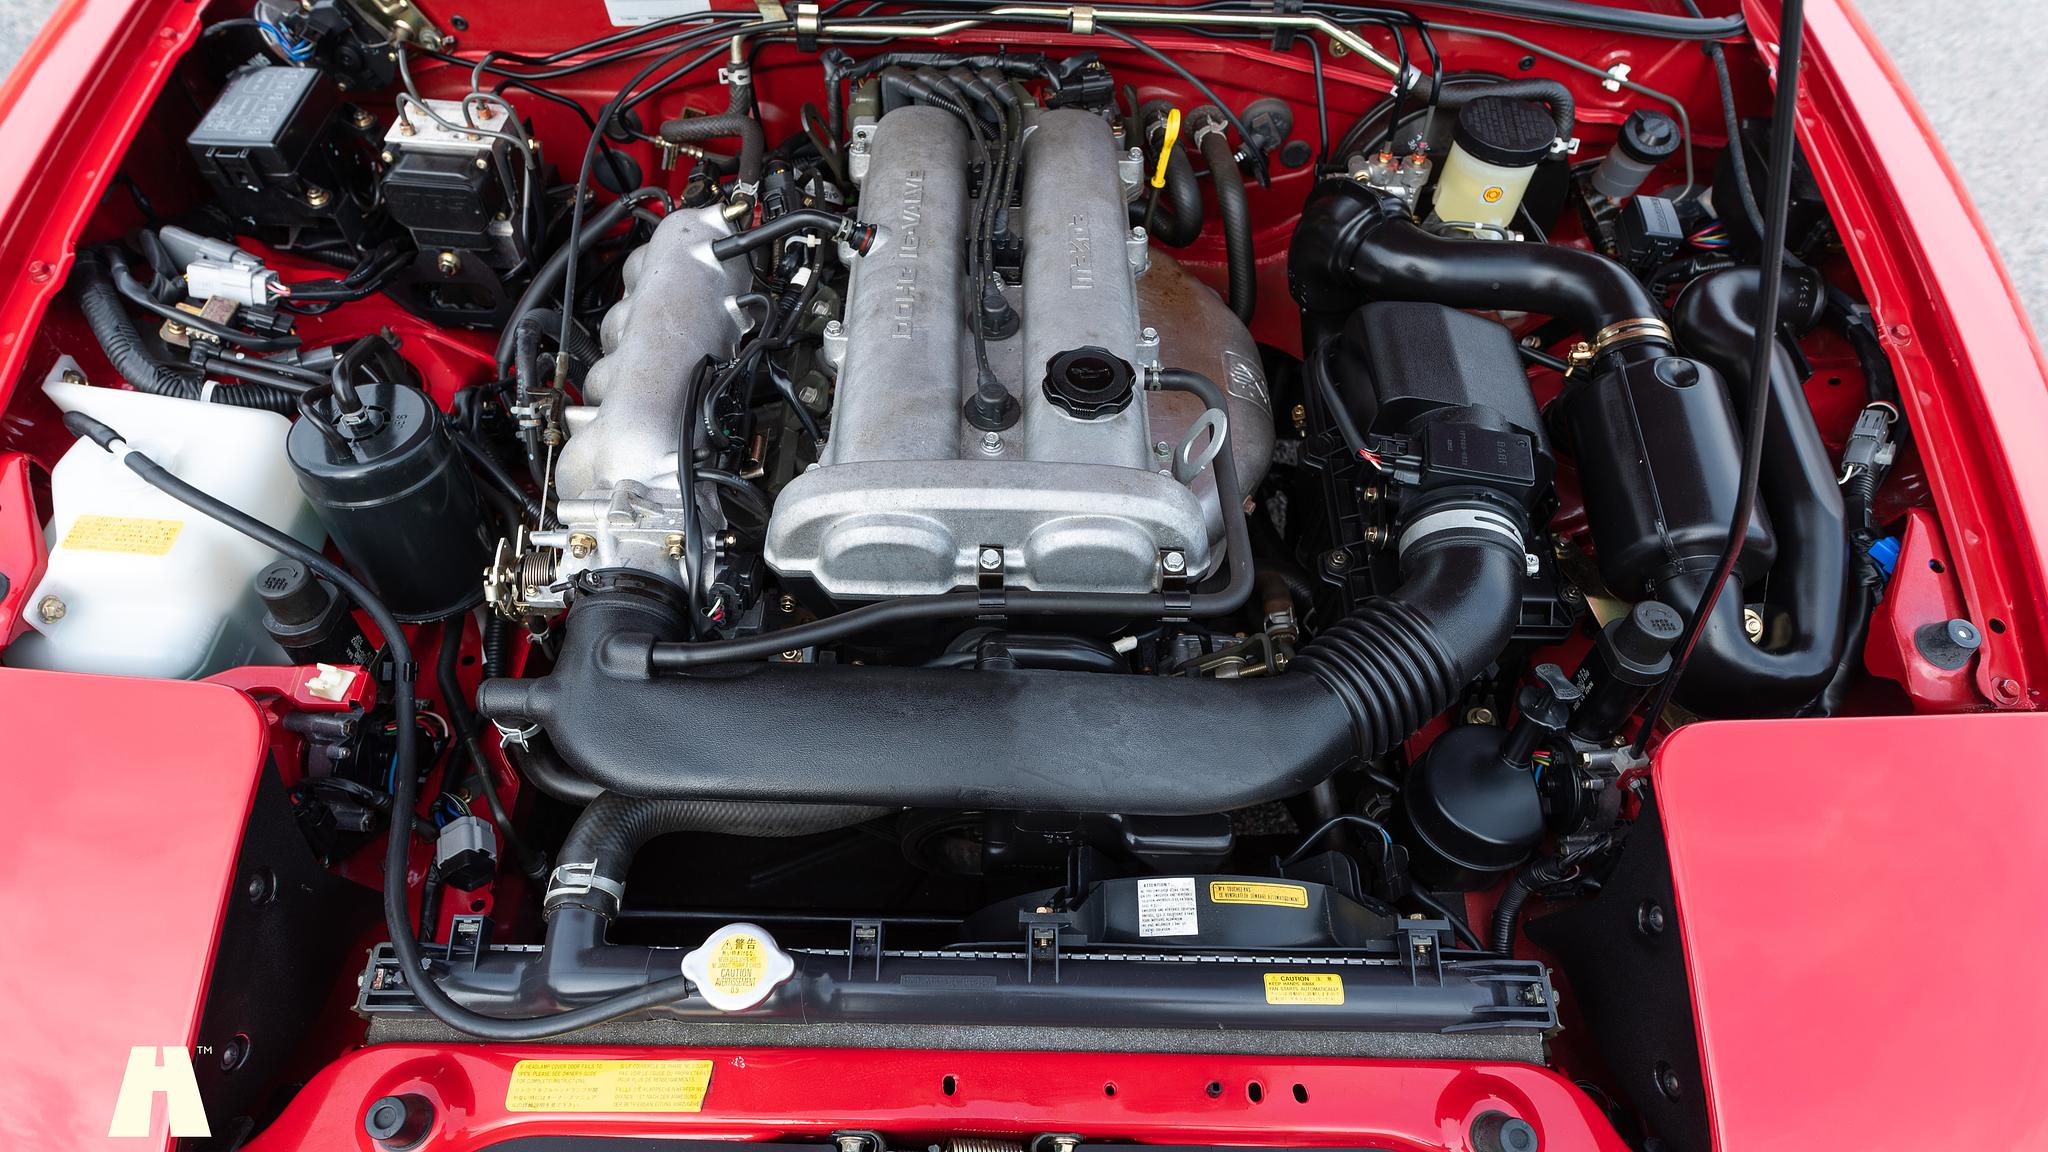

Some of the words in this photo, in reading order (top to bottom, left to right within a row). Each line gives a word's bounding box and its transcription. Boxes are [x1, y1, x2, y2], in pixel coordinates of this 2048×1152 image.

[898, 169, 925, 259] 16-VALVE
[892, 267, 917, 340] DOHC
[735, 938, 757, 949] 警告
[720, 968, 752, 978] CAUTION
[715, 978, 756, 987] AVERTISSEMENT
